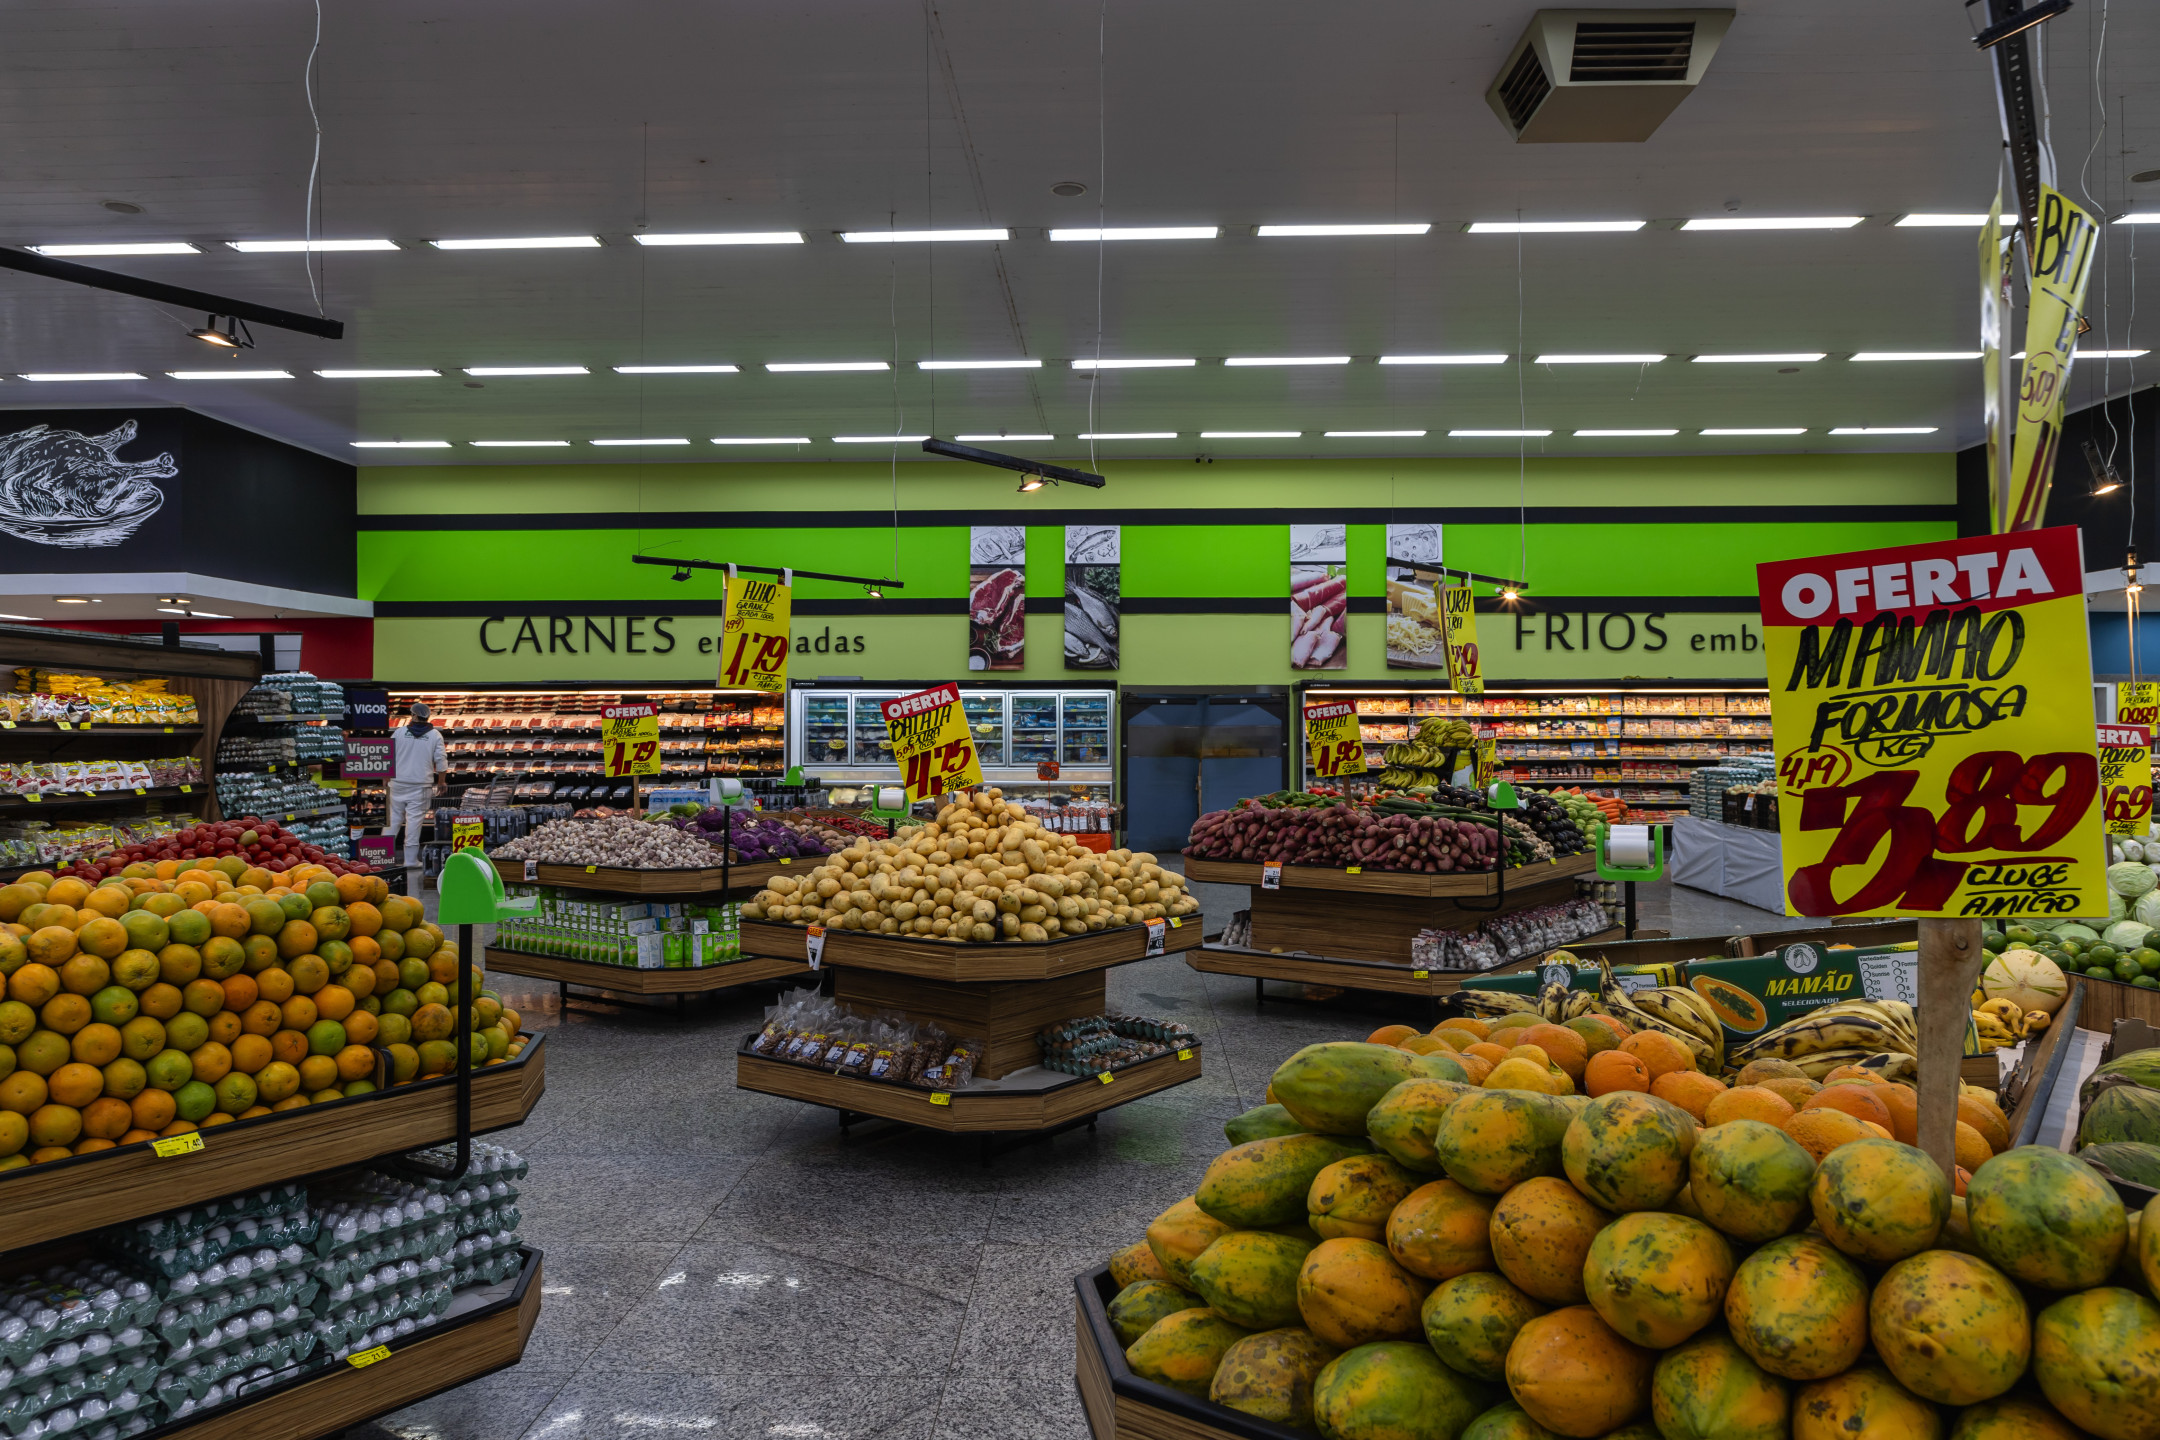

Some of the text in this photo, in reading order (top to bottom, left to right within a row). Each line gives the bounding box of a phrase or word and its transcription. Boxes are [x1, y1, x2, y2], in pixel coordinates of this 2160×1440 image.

[1781, 547, 2055, 619] OFERTA
[479, 616, 865, 654] CARNES eadas
[1515, 612, 1767, 651] FRIOS emb
[724, 632, 788, 685] 1,79
[354, 703, 388, 714] VIGOR
[605, 706, 653, 718] OFERTA
[888, 688, 955, 718] OFERTA
[1307, 704, 1352, 719] OFERTA
[889, 704, 952, 742] BATATA
[1309, 714, 1348, 734] BATATA
[1810, 685, 2027, 752] FORMOSA
[907, 727, 941, 746] EXTRA
[1478, 729, 1495, 739] OFERTA
[2097, 729, 2144, 745] ERTA
[347, 743, 389, 756] Vigore
[1875, 734, 1925, 758] KG
[346, 758, 390, 771] sabor
[1779, 753, 1839, 789] 4,19
[360, 848, 386, 858] Vigore
[1967, 864, 2069, 887] CLUBE
[1960, 888, 2081, 917] AMIGO
[1765, 970, 1854, 997] MAMÃO
[1782, 998, 1840, 1007] SELECIONADO
